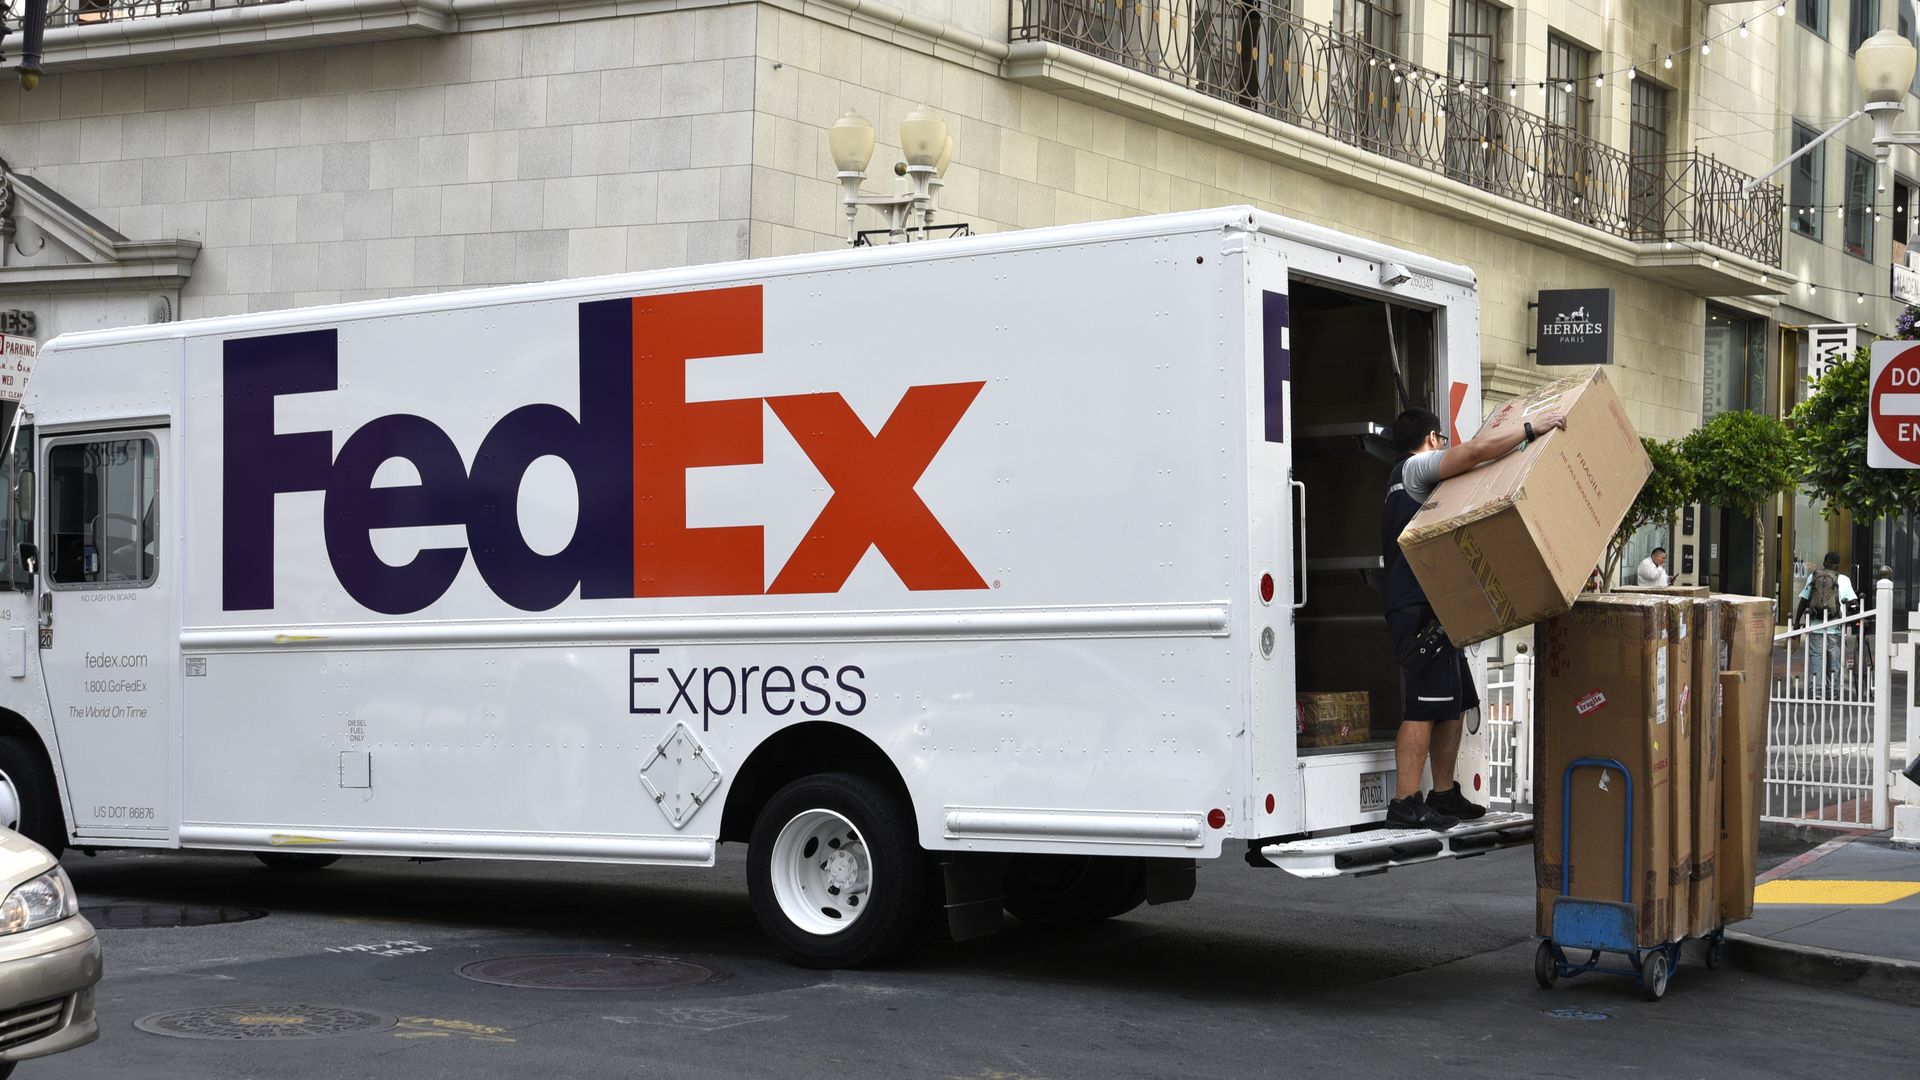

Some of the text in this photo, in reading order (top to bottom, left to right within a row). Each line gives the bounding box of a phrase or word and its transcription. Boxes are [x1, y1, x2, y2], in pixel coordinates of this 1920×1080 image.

[1559, 336, 1585, 344] PARIS
[5, 341, 35, 358] PARKING
[2, 374, 14, 386] WED
[1891, 367, 1920, 387] DO
[223, 285, 990, 615] FedEx
[1567, 464, 1577, 481] PAS
[1576, 452, 1603, 500] FRAGILE
[90, 594, 106, 602] CASH
[106, 594, 116, 602] ON
[117, 592, 137, 601] BOARD
[41, 634, 51, 648] 20
[84, 651, 148, 669] fedex.com
[84, 679, 147, 693] 1.800.GoFedEx
[628, 647, 867, 732] Express
[69, 705, 147, 718] The World On Time
[347, 719, 367, 727] DIESEL
[350, 727, 364, 735] FUEL
[350, 734, 365, 742] ONLY
[93, 805, 155, 820] US DOT 86876
